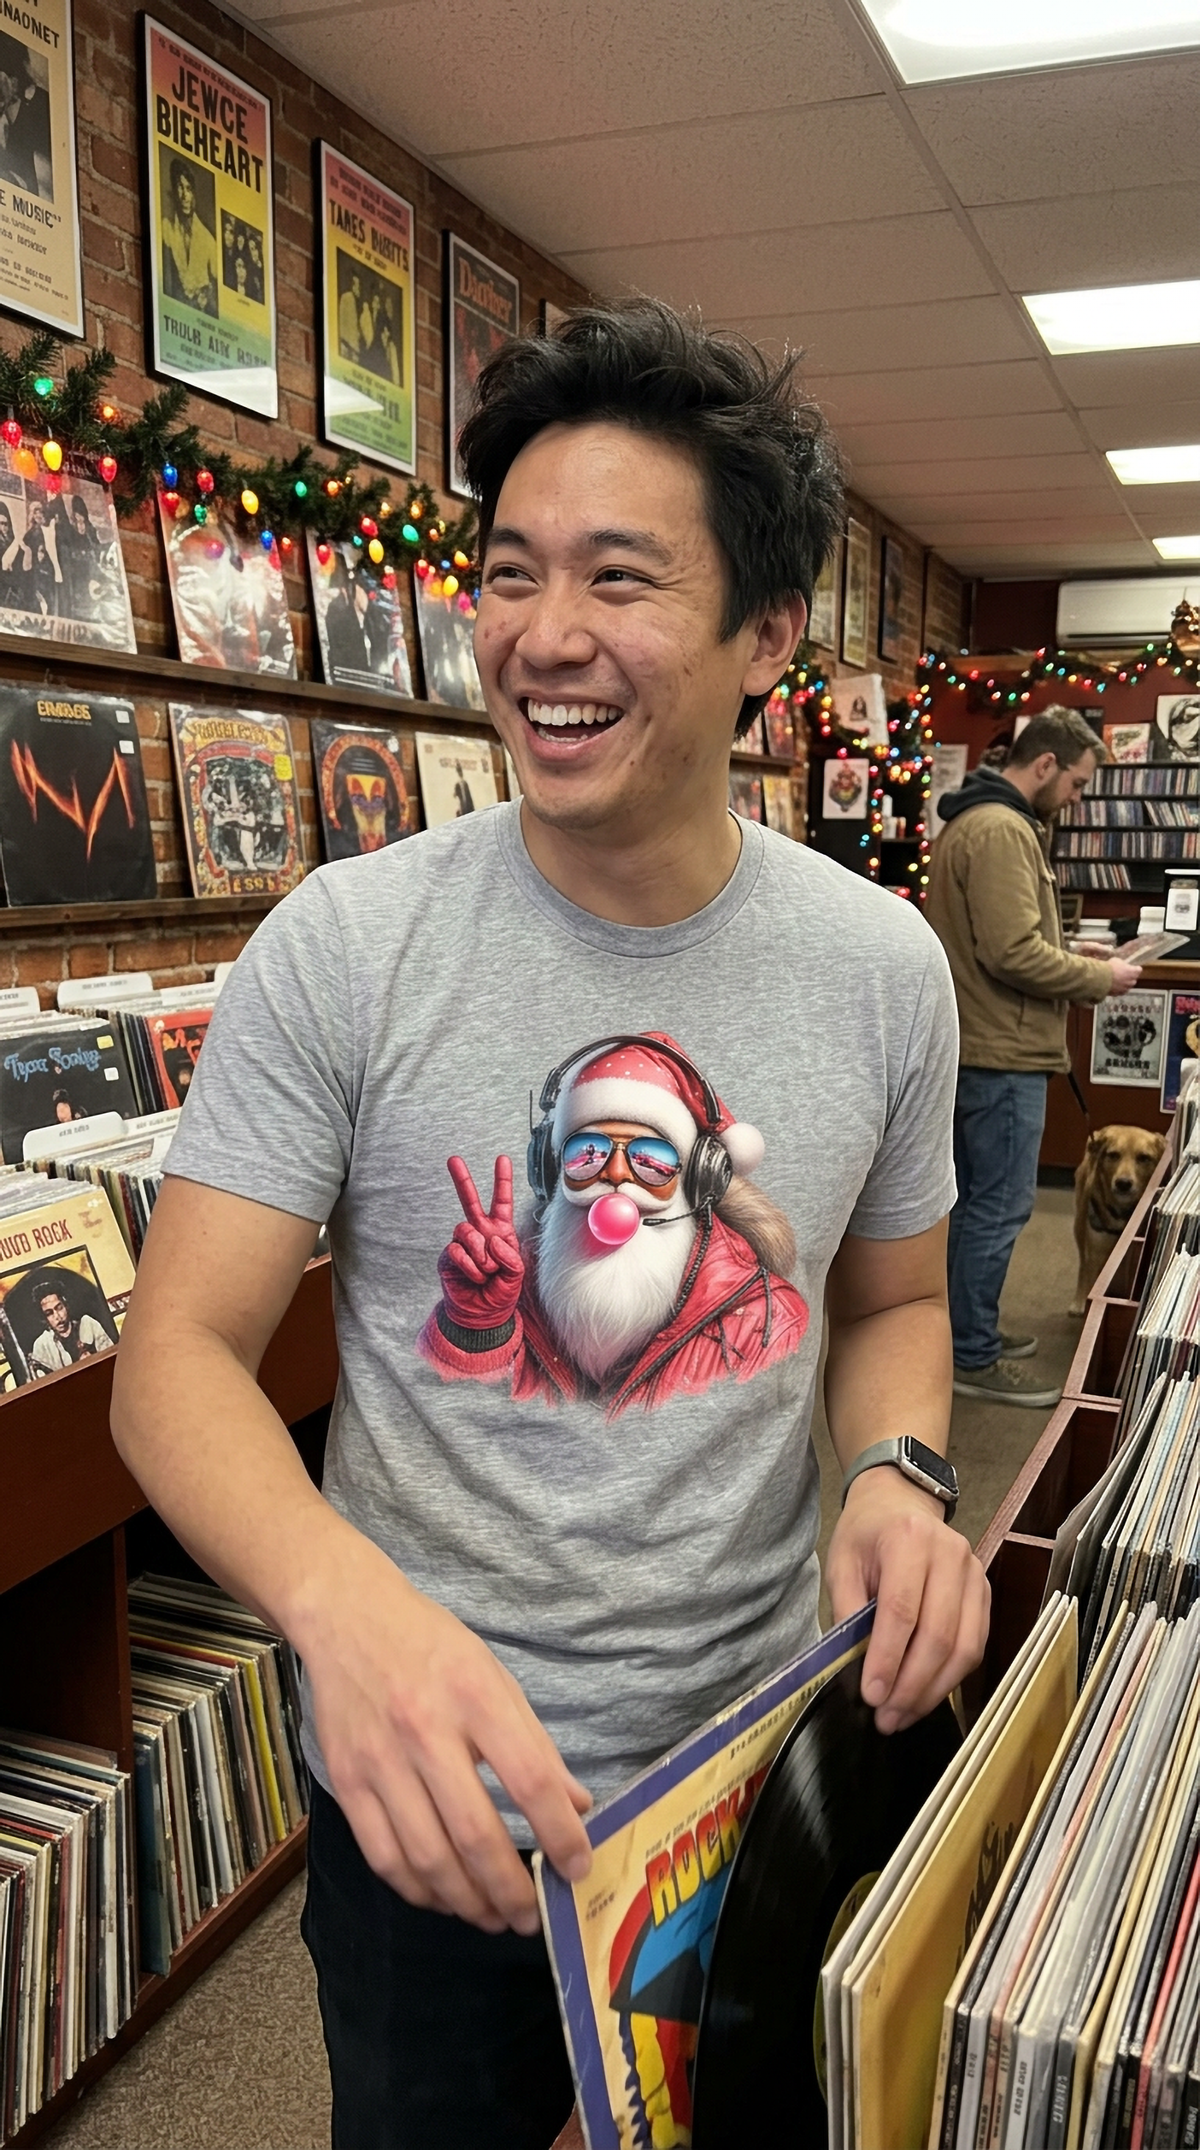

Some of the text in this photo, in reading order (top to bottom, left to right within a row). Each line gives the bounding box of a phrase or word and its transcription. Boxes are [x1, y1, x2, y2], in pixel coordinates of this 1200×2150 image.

[156, 94, 263, 194] BIEHEART
[172, 65, 247, 145] JEWCE
[31, 1219, 73, 1249] ROCK
